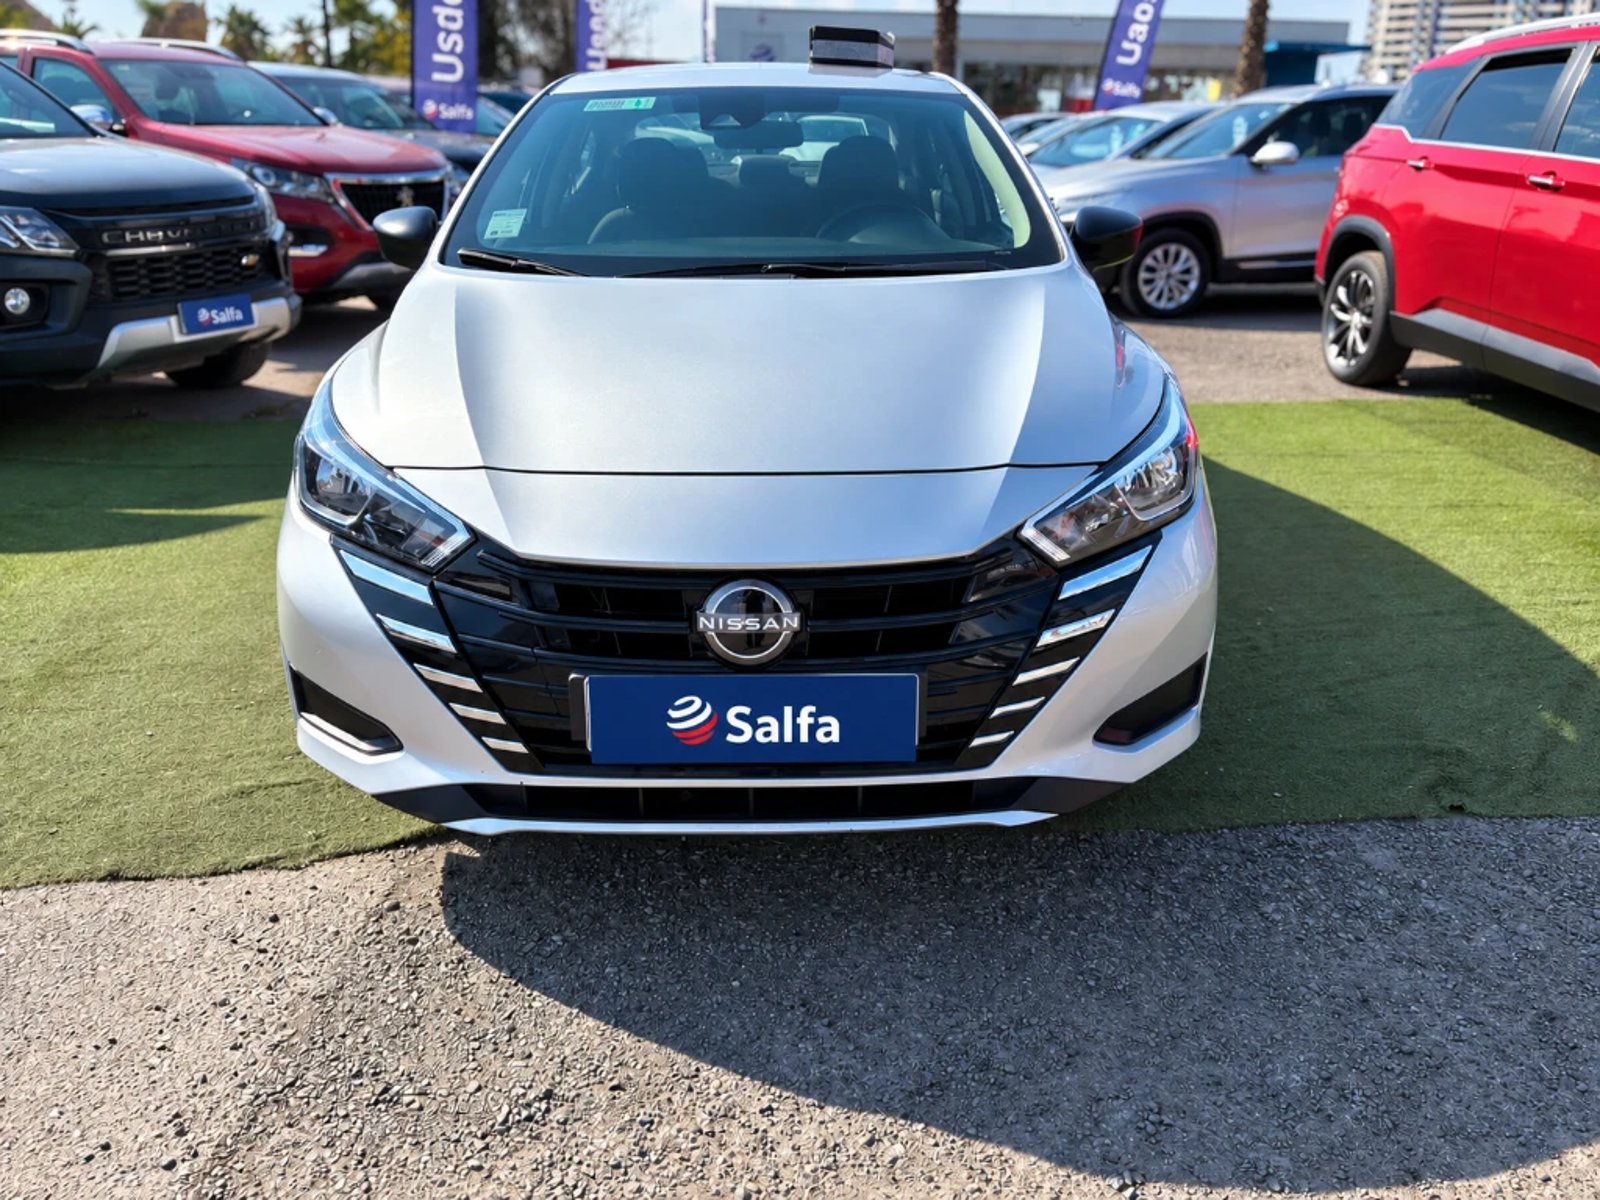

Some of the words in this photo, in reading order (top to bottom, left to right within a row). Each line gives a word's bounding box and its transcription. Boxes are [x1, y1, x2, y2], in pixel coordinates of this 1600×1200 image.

[431, 0, 464, 83] Usd
[1115, 0, 1157, 66] Uao
[210, 306, 244, 324] Salfa
[699, 616, 799, 631] NISSAN
[725, 704, 840, 744] Salfa
